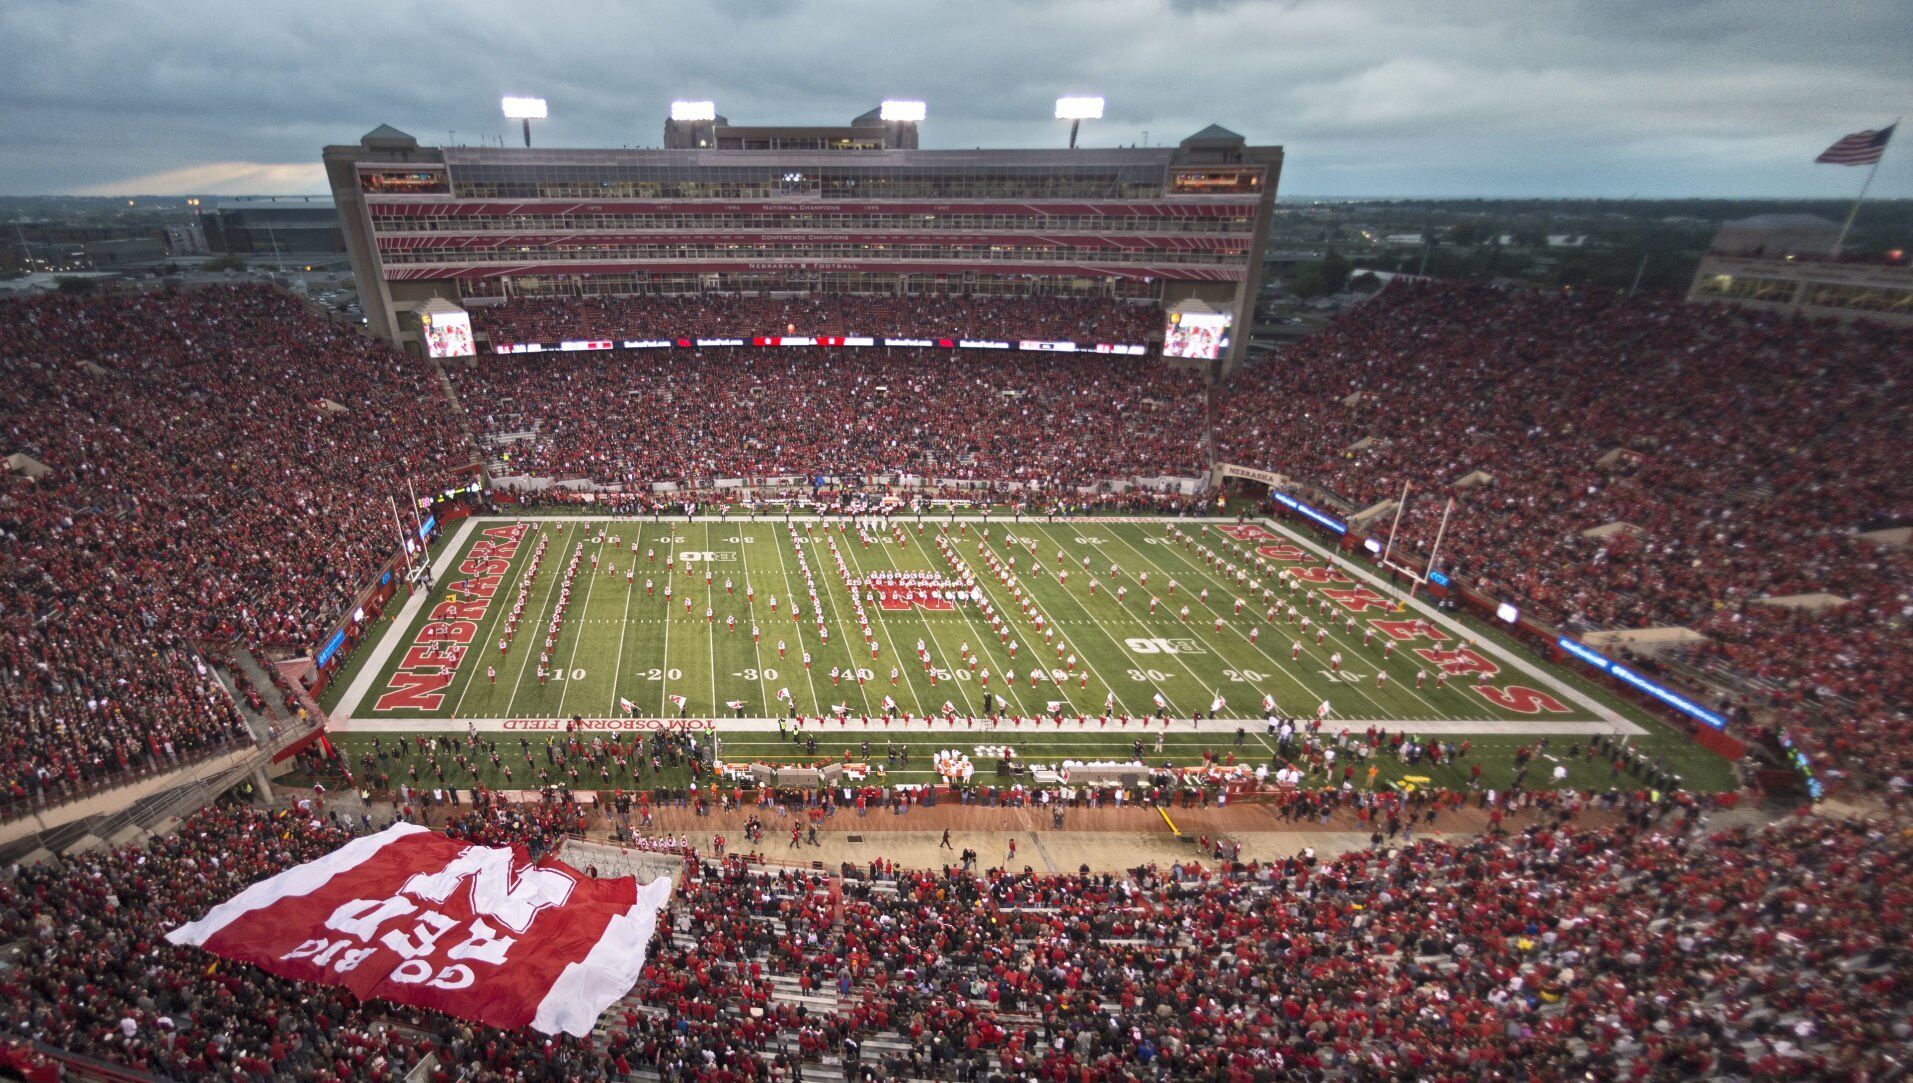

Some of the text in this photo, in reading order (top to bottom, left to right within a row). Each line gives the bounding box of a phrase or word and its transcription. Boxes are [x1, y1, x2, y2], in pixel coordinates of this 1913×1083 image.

[1229, 467, 1274, 482] NEBRASKA
[373, 523, 530, 711] NEBRASKA
[1214, 524, 1575, 713] HUSKERS
[647, 668, 683, 681] 20
[743, 668, 779, 681] 30
[503, 719, 560, 730] FIELD
[669, 719, 716, 730] TOM
[396, 845, 577, 934] N
[325, 896, 518, 965] RED
[279, 937, 475, 989] GO BIG
